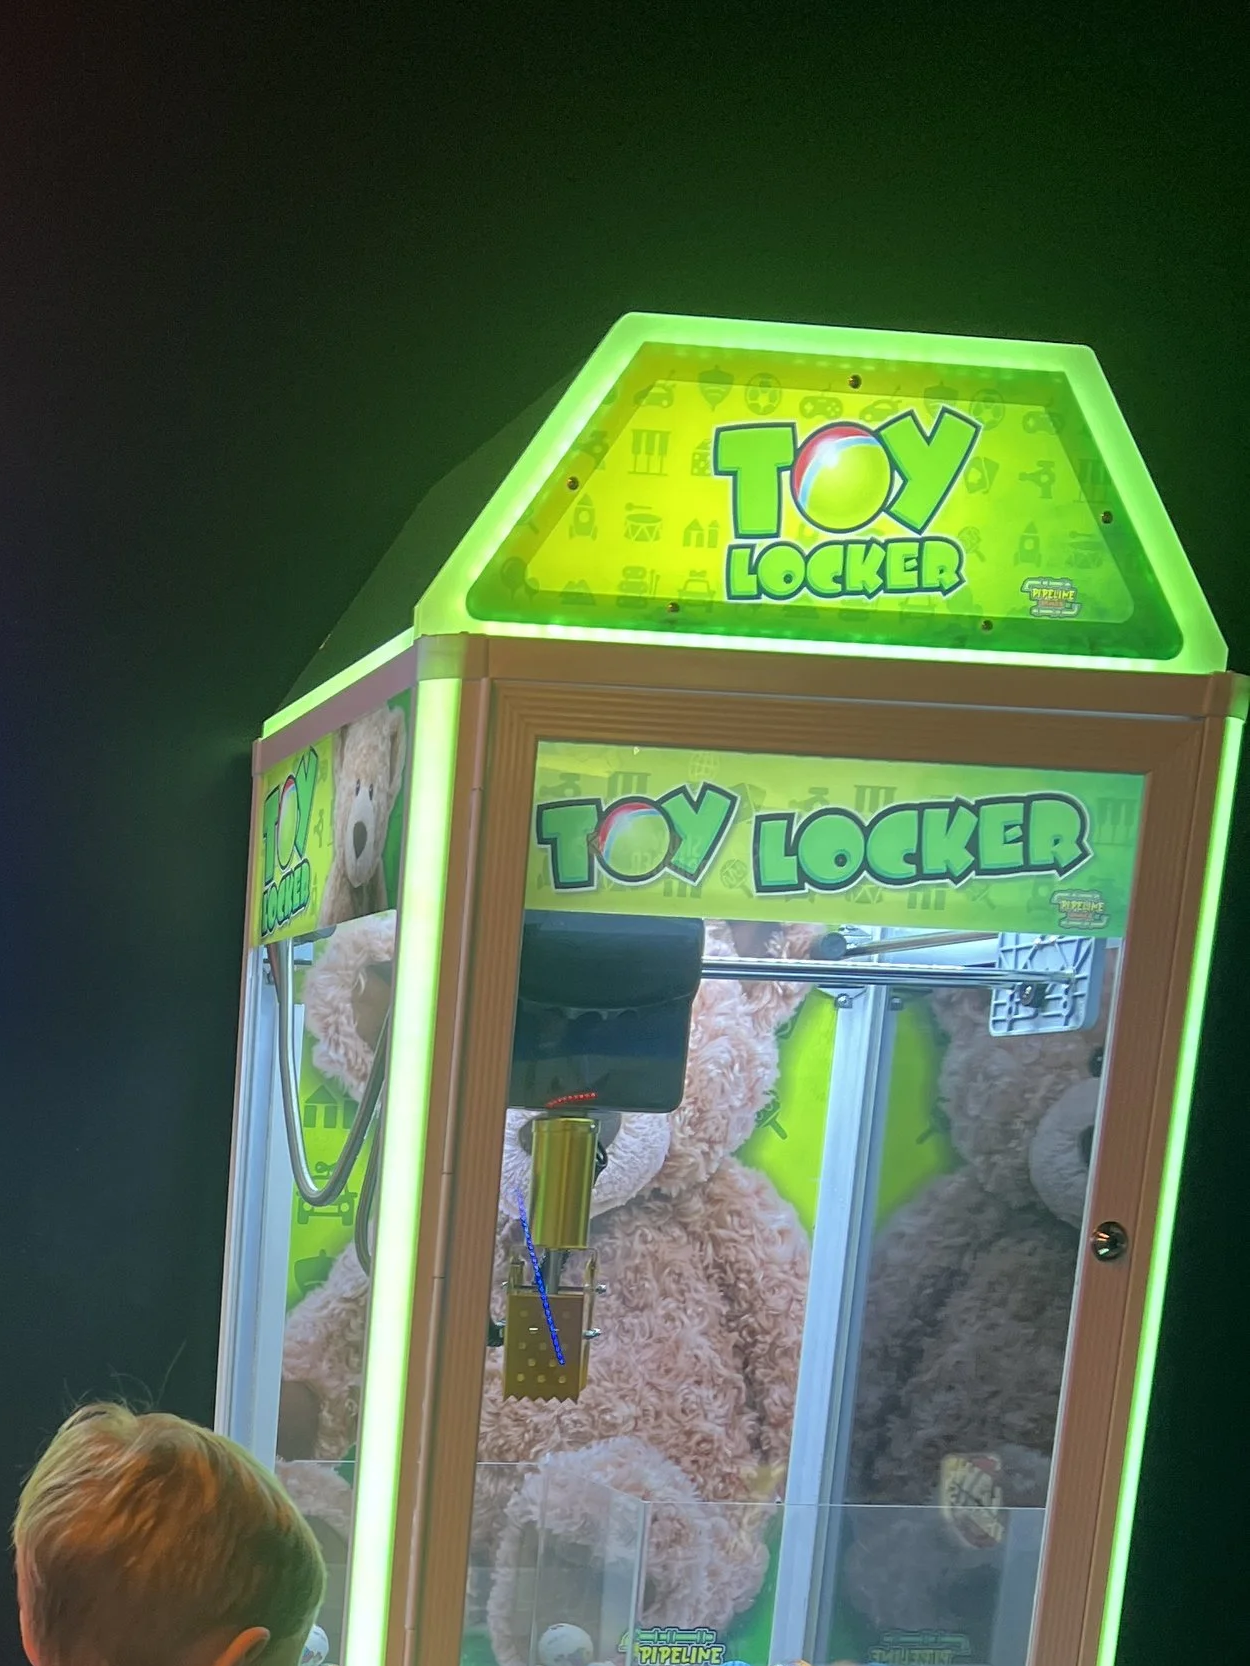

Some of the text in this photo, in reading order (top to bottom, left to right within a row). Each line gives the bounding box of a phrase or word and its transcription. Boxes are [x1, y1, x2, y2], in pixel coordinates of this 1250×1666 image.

[712, 406, 984, 538] TOY
[724, 536, 966, 600] LOCKER
[263, 745, 319, 887] TOY
[538, 782, 739, 891] TOY
[753, 793, 1093, 894] LOCKER
[261, 858, 311, 937] LOCKER
[639, 1646, 723, 1664] PIPELINE
